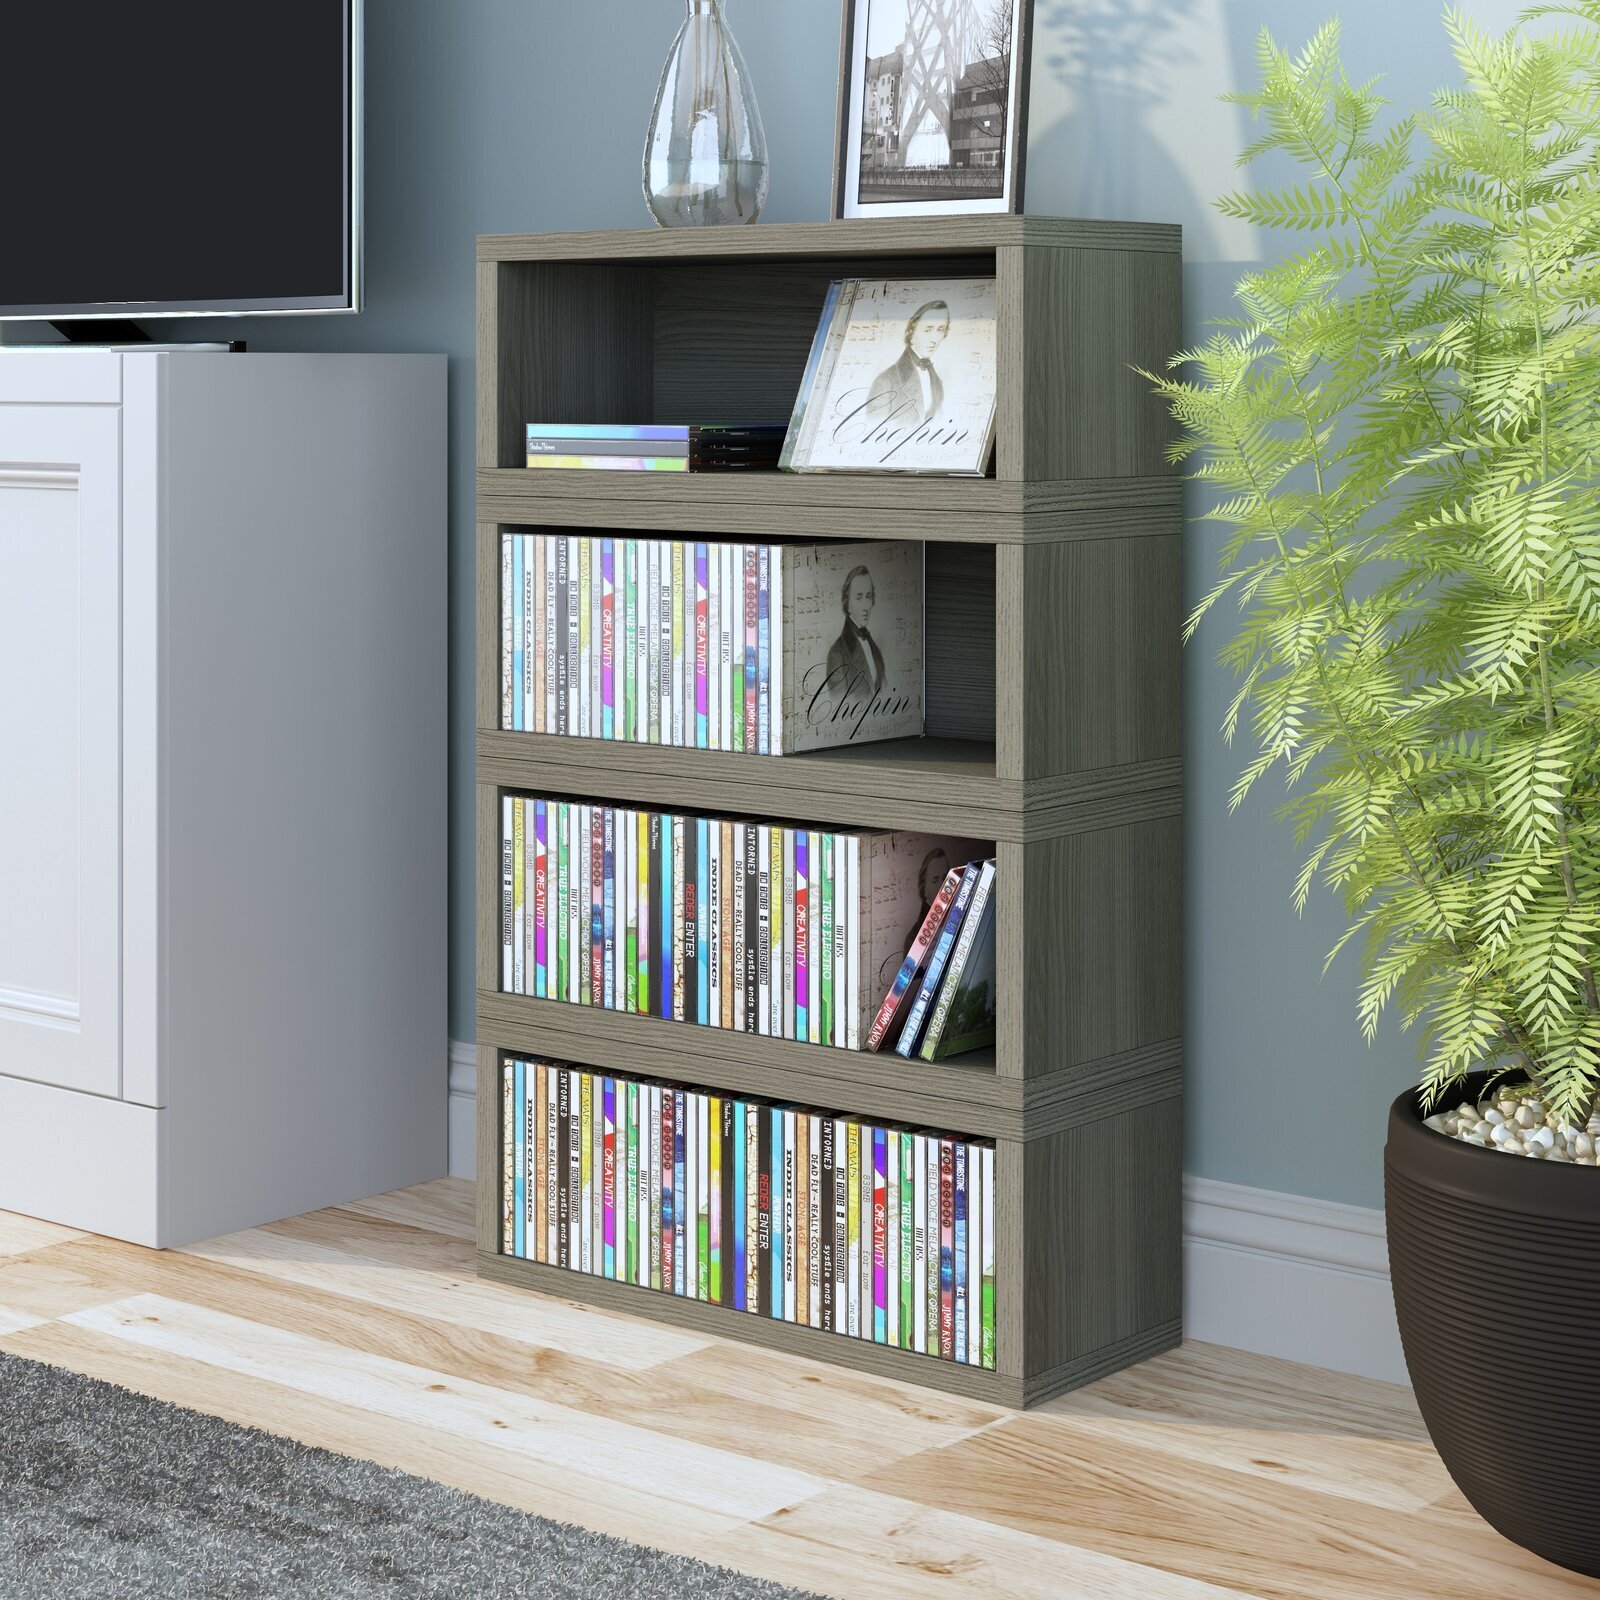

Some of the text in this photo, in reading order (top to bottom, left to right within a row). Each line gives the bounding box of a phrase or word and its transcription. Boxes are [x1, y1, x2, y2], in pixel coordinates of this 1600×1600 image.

[833, 387, 969, 463] Chopin
[650, 564, 658, 589] FIELD
[650, 592, 658, 619] VOICE
[536, 607, 544, 659] STONE AGE
[547, 572, 555, 696] DEAD FLY REALLY COOL STUFF
[603, 609, 612, 668] CREATIVITY
[627, 603, 635, 679] TRUE ELECTRO
[662, 586, 670, 696] IN THIS COLLECTION
[696, 615, 706, 676] CREATIVITY
[650, 690, 658, 720] OPERA
[747, 701, 755, 749] JIMMY KNOX
[802, 663, 911, 740] Chopin
[748, 828, 756, 875] INTORNED
[536, 869, 545, 929] CREATIVITY
[559, 865, 567, 940] TRUE ELECTRO
[582, 828, 590, 982] FIELD VOICE MELANCHOLY OPERA
[685, 884, 694, 957] REDER ENTER
[722, 897, 731, 951] STONE AGE
[973, 886, 987, 914] FIELD
[735, 860, 743, 991] DEAD FLY REALLY COOL STUFF
[760, 871, 768, 986] IN THIS COLLECTION
[797, 904, 806, 967] CREATIVITY
[823, 900, 831, 980] TRUE ELECTRO
[961, 914, 977, 944] VOICE
[593, 957, 601, 1003] JIMMY KNOX
[785, 951, 793, 968] for
[785, 973, 793, 990] now
[868, 1023, 884, 1046] KNOX
[879, 1003, 893, 1026] JIMMY
[929, 1007, 945, 1037] OPERA
[676, 1093, 684, 1136] THE TOMBSTONE
[537, 1137, 545, 1189] STONE AGE
[824, 1122, 832, 1170] INTORNED
[849, 1127, 857, 1178] THE MAPS
[956, 1146, 965, 1191] THE TOMBSTONE
[604, 1148, 613, 1208] CREATIVITY
[628, 1145, 637, 1221] TRUE ELECTRO
[651, 1110, 660, 1266] FIELD VOICE MELANCHOLY OPERA
[759, 1174, 768, 1249] REDER ENTER
[798, 1191, 806, 1246] STONE AGE
[836, 1167, 845, 1283] IN THIS COLLECTION
[875, 1203, 884, 1267] CREATIVITY
[663, 1241, 672, 1288] JIMMY KNOX
[823, 1245, 831, 1277] sysfile
[862, 1250, 871, 1267] for
[901, 1200, 911, 1282] TRUE ELECTRO
[929, 1163, 937, 1331] FIELD VOICE MELANCHOLY OPERA
[823, 1283, 831, 1304] ends
[862, 1272, 871, 1290] now
[956, 1286, 965, 1298] ALL
[942, 1304, 951, 1355] JIMMY KNOX
